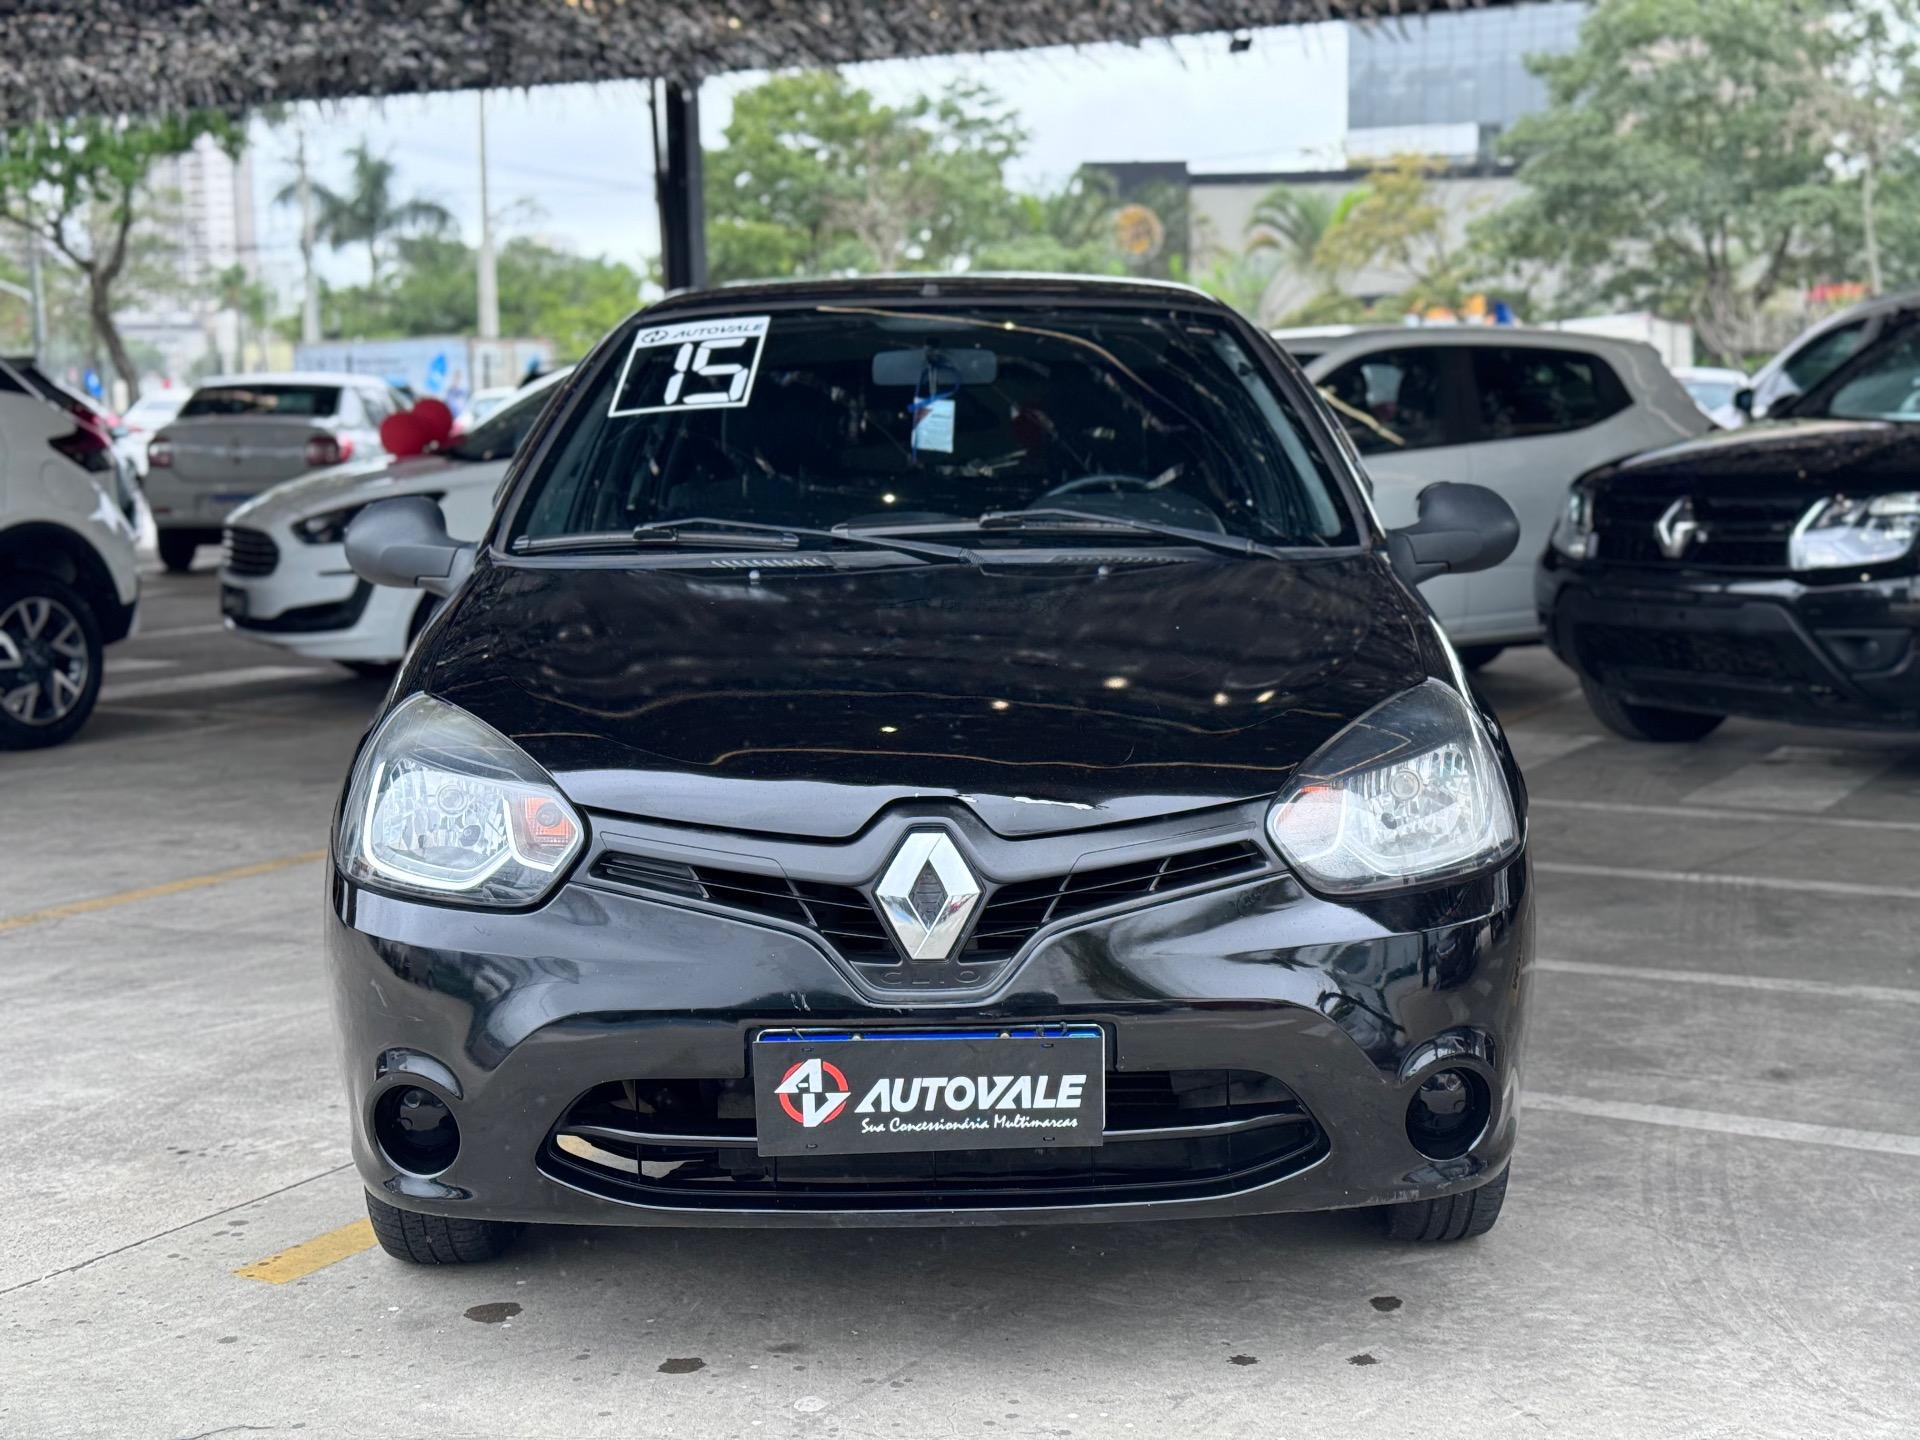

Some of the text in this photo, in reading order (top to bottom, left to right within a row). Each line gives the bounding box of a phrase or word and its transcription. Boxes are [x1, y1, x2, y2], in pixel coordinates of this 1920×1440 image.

[671, 323, 764, 339] AUTOVALE
[663, 337, 749, 405] 15
[854, 1074, 1087, 1113] AUTOVALE
[861, 1114, 1079, 1133] Sua Concessionária Multimarcas
